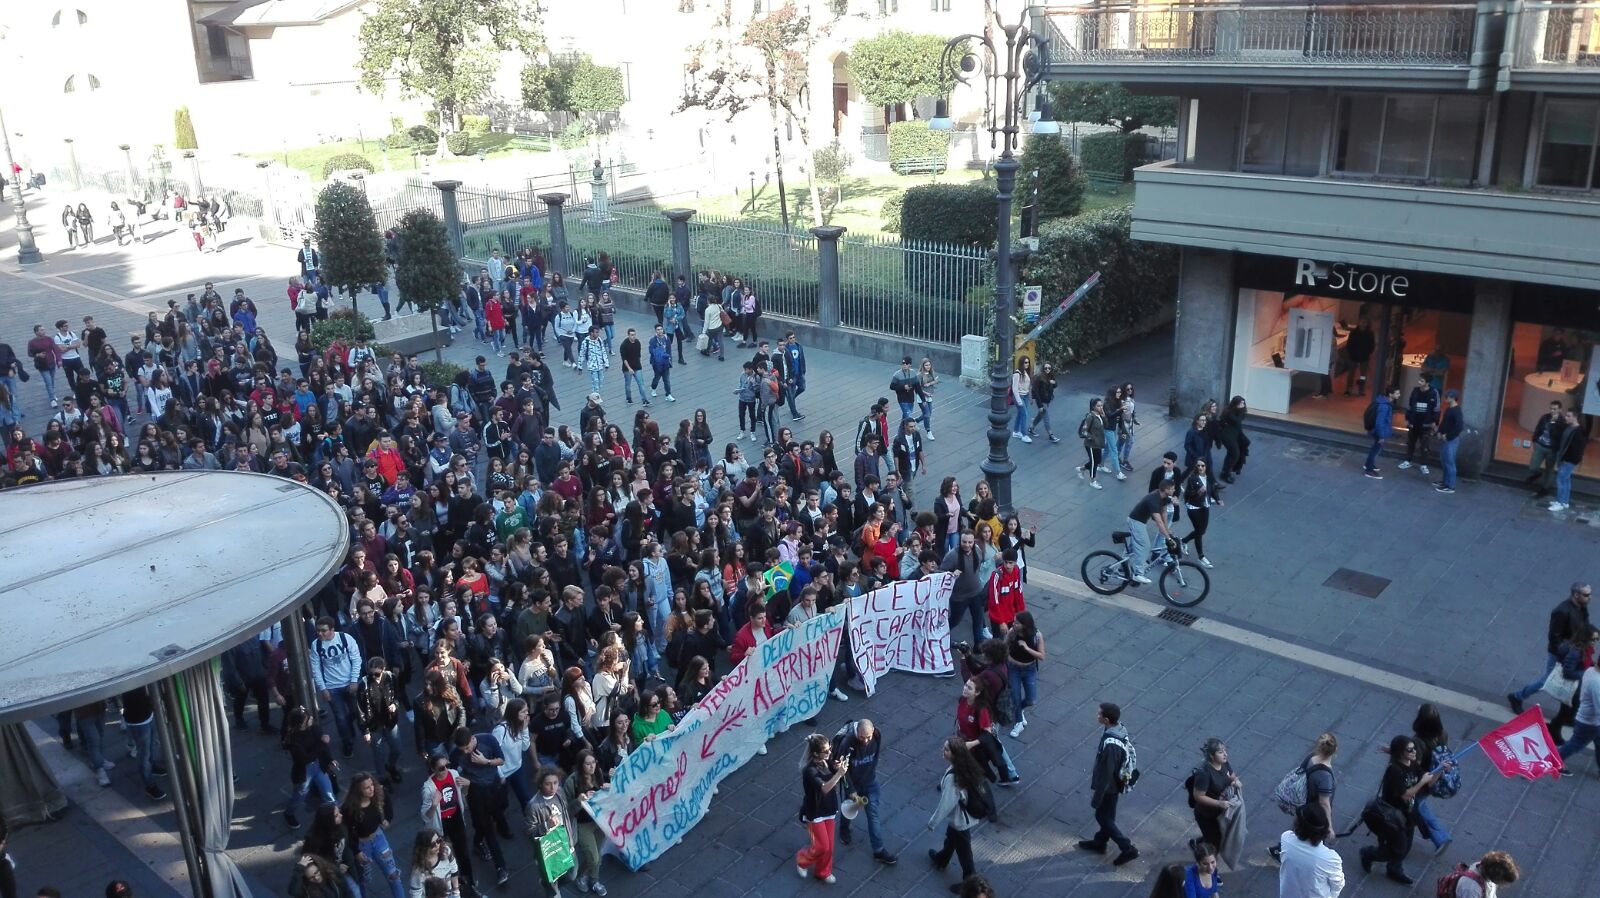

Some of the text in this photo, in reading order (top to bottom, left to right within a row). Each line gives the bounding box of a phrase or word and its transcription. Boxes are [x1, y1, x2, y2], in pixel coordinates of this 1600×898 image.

[849, 577, 932, 621] LICEO
[763, 628, 795, 668] DEVO
[851, 620, 873, 654] DE
[1494, 739, 1517, 761] UNIONE
